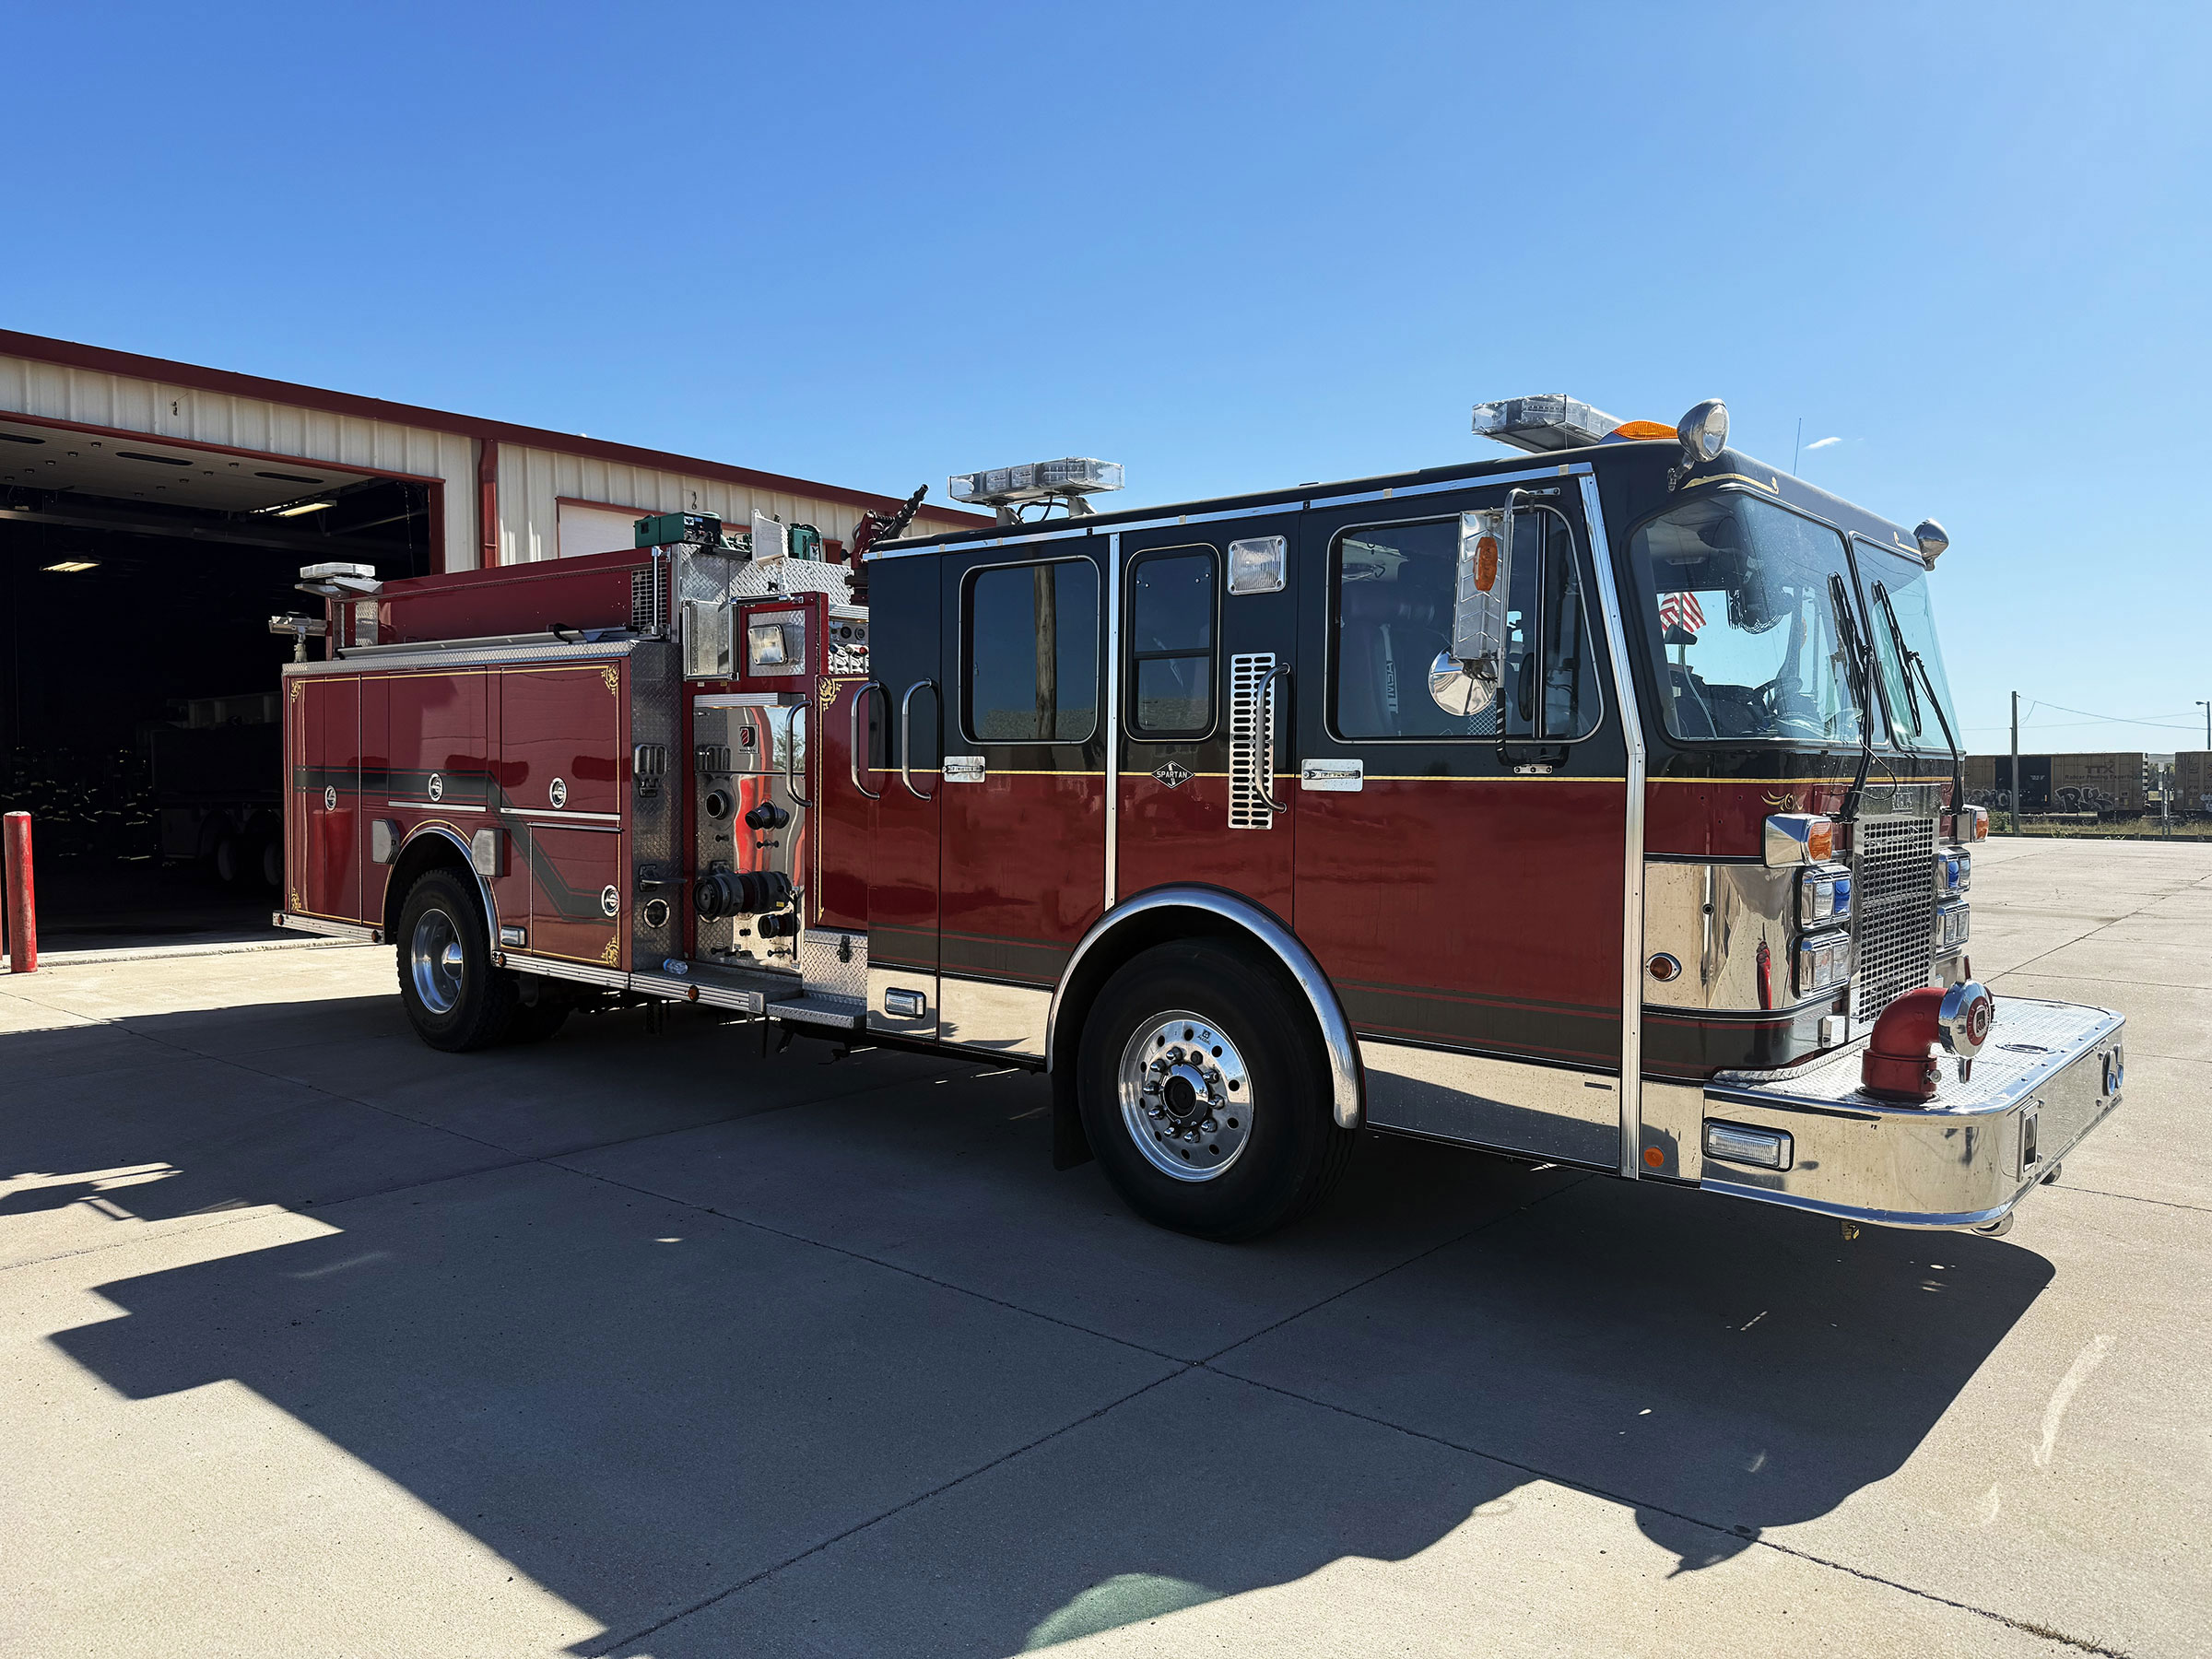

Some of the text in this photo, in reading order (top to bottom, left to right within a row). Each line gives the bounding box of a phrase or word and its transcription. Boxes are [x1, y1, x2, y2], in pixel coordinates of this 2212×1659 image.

[1386, 662, 1394, 696] MSA
[2084, 764, 2115, 774] TTX
[1156, 771, 1188, 779] SPARTAN
